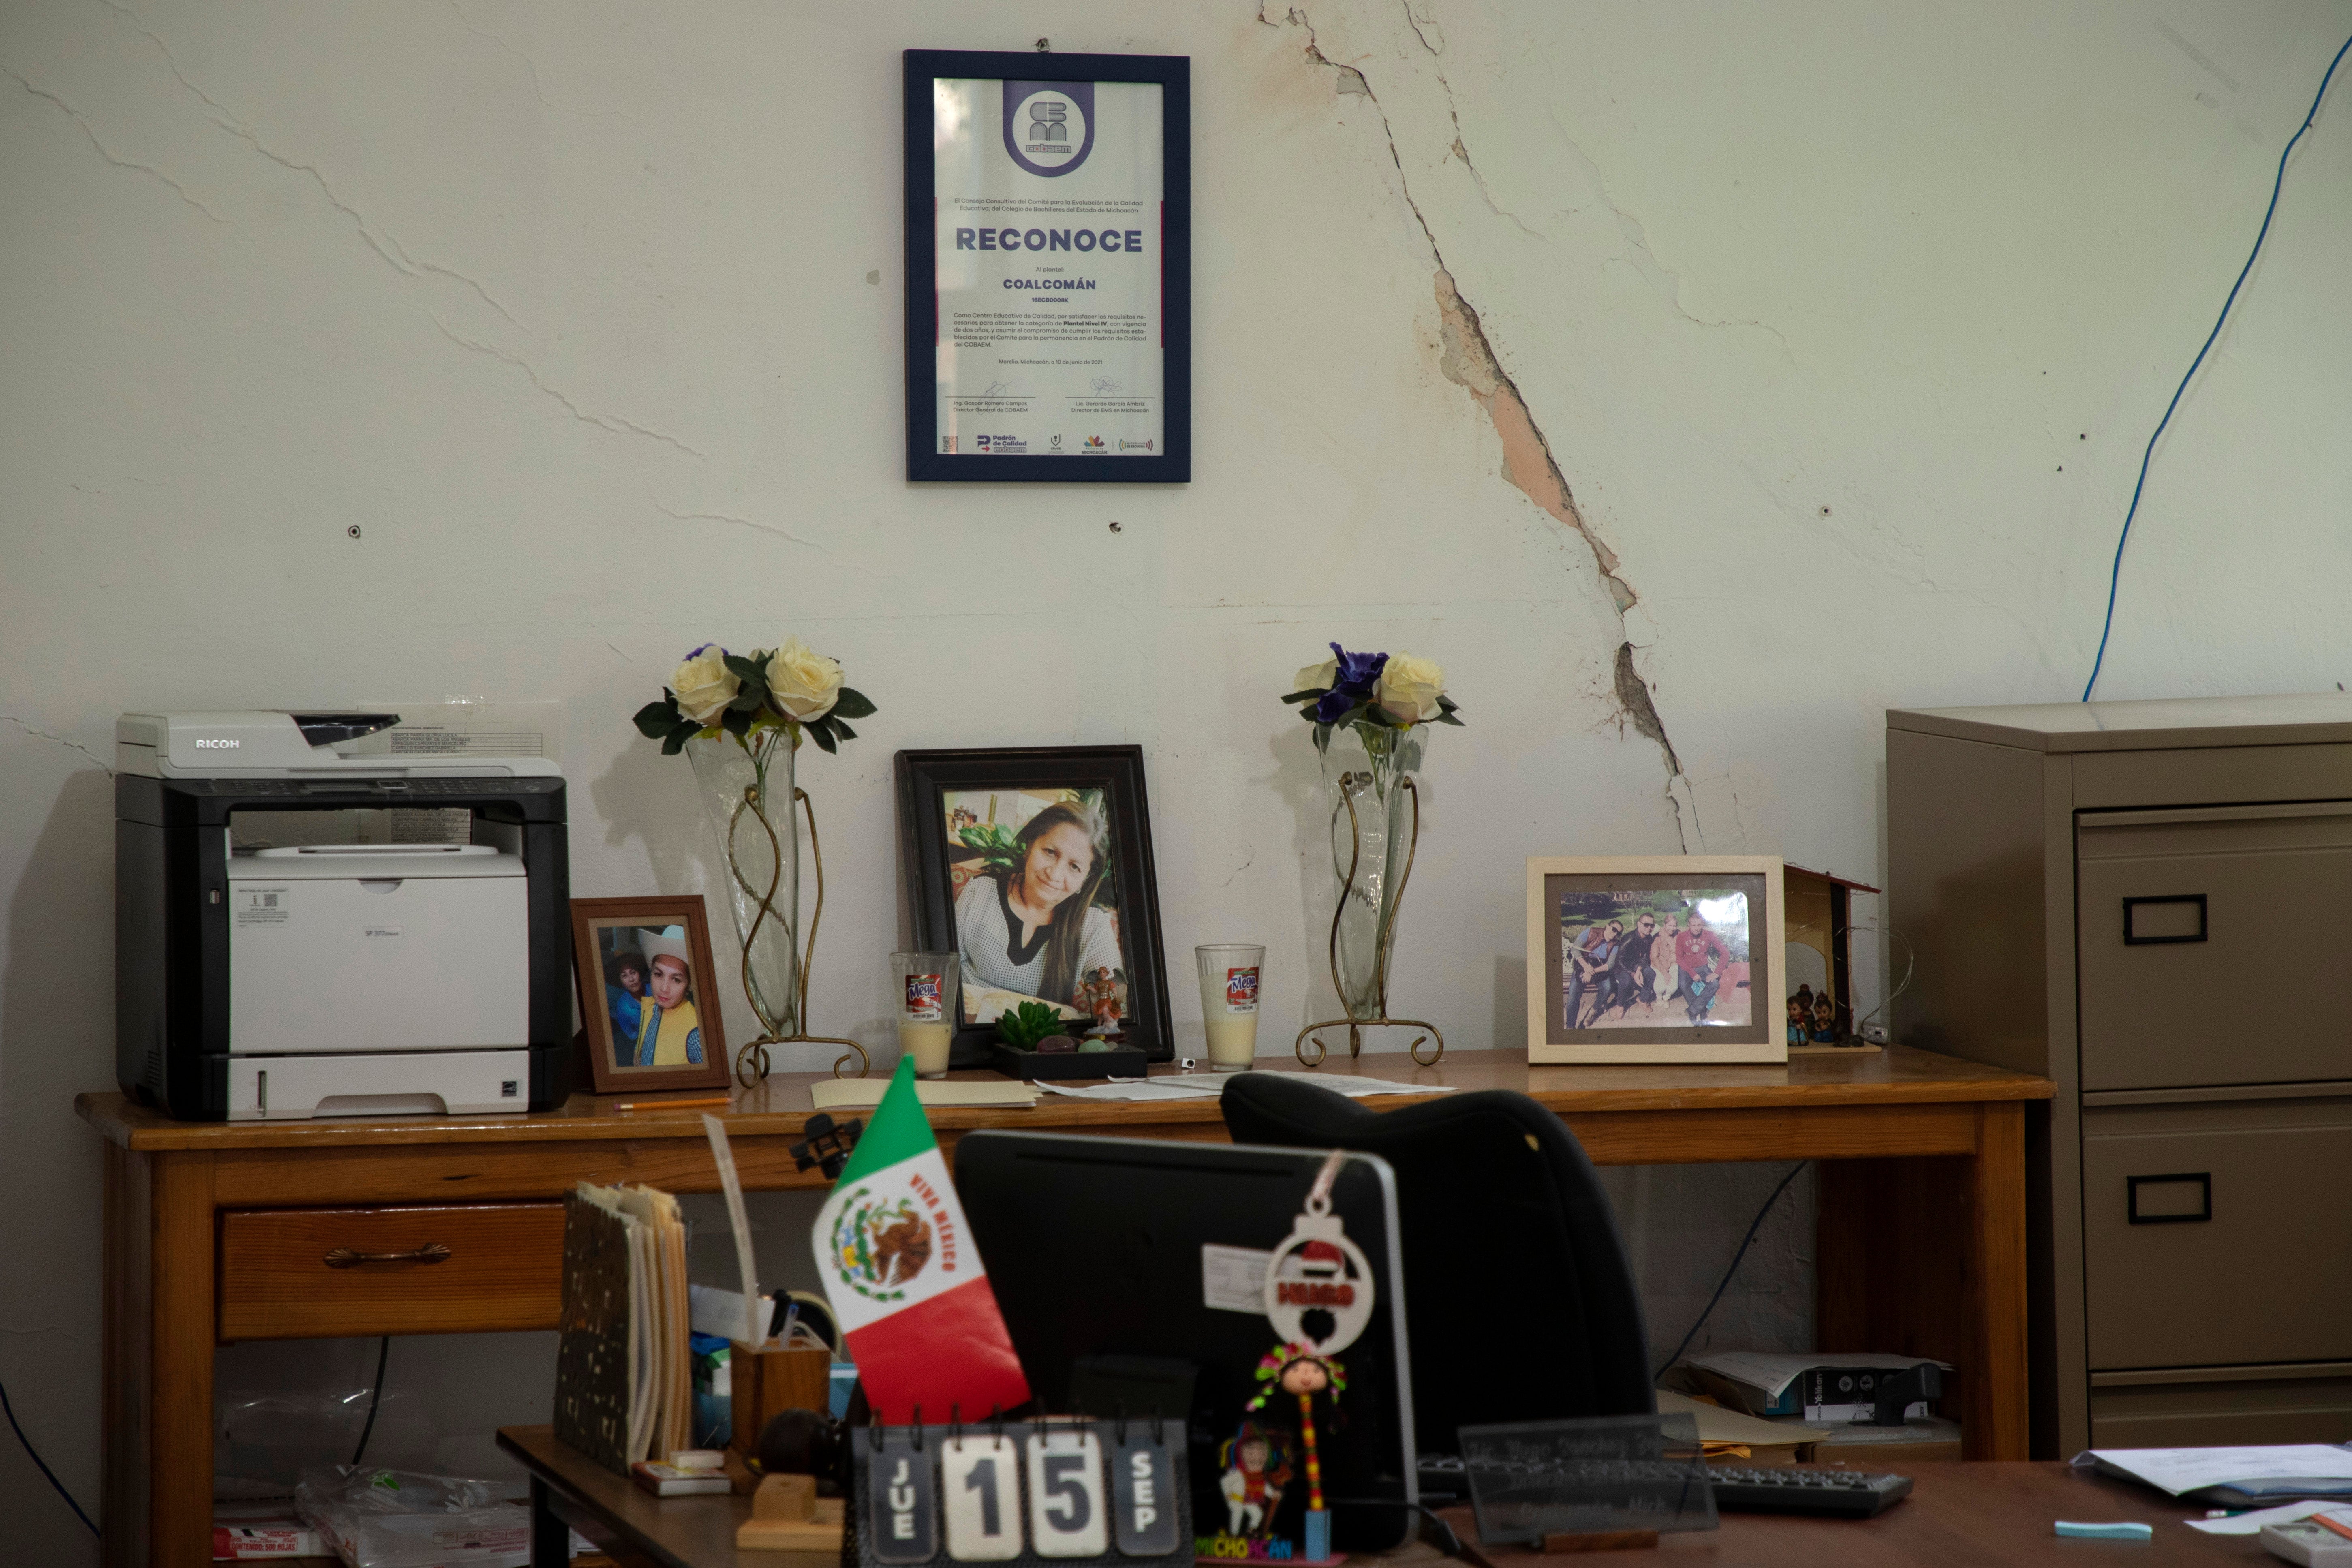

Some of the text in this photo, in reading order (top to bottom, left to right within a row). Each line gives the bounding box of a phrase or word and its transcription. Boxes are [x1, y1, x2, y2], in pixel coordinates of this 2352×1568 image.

[956, 227, 1142, 252] RECONOCE
[1003, 277, 1096, 290] COALCOMÁN
[195, 740, 239, 749] RICOH
[909, 983, 936, 1000] Mega
[1232, 976, 1255, 992] Mega
[909, 1174, 940, 1209] VIVA
[1814, 1373, 1823, 1404] Yolikan
[887, 1459, 916, 1540] JUE
[1130, 1452, 1158, 1533] SEP
[490, 1545, 526, 1554] Marathon
